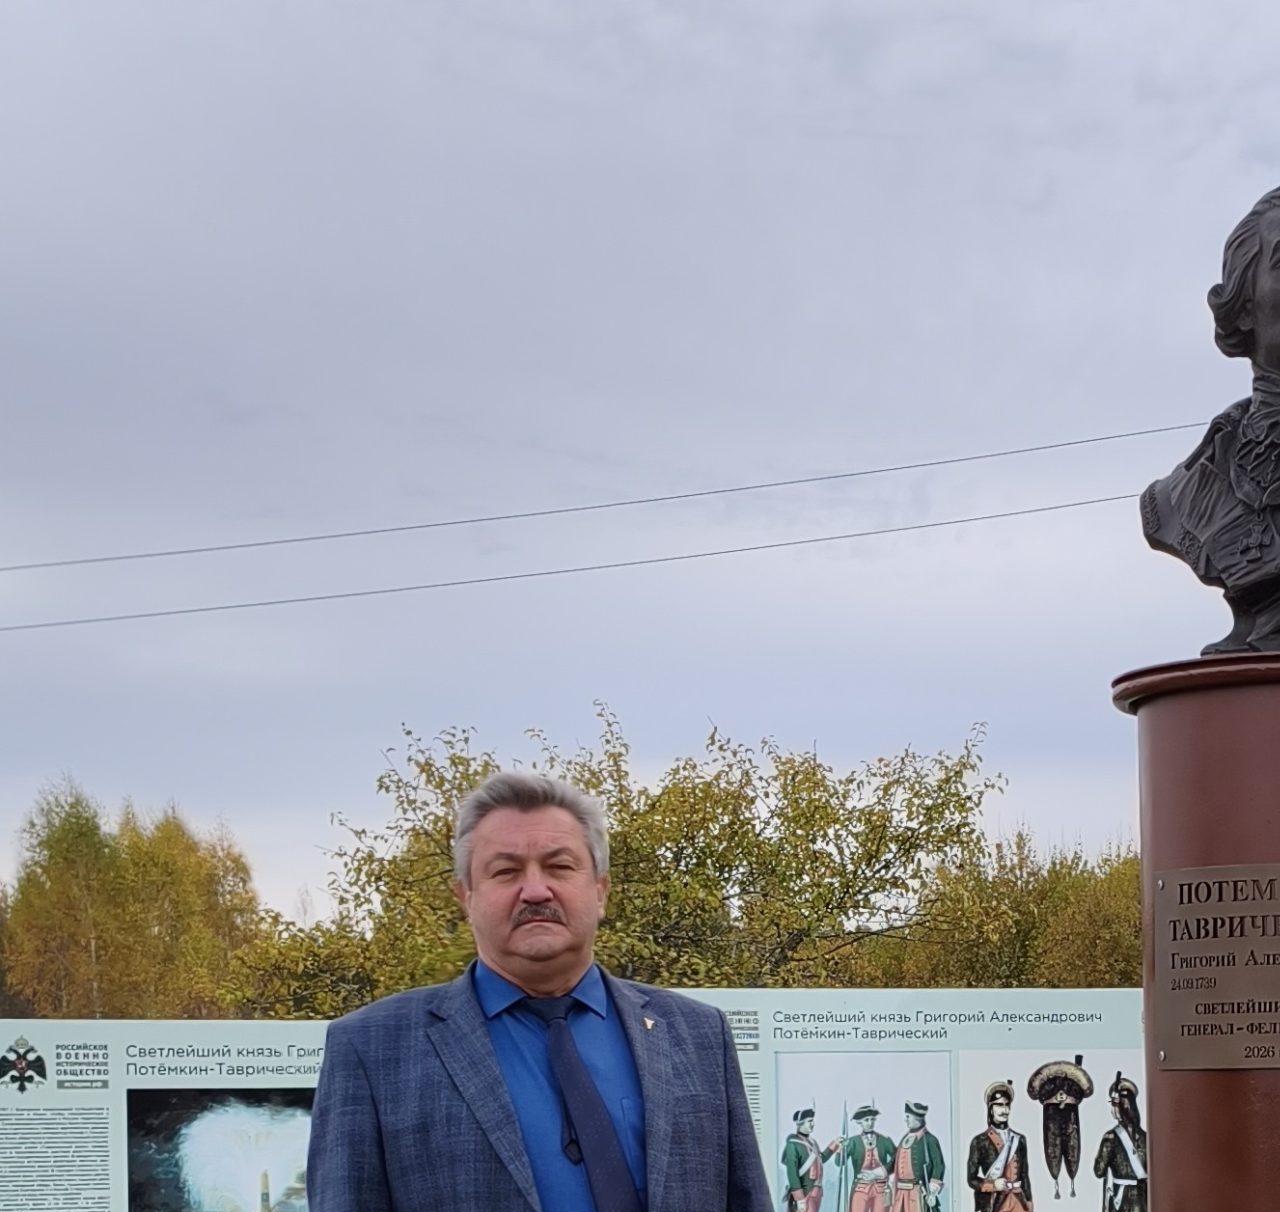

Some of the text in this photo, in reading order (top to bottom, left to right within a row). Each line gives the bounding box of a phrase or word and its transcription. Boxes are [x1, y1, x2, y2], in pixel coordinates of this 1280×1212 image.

[773, 1010, 1103, 1027] Светлейший князь Григорий Александрович
[773, 1026, 948, 1042] Потёмкин-Таврический
[56, 1043, 108, 1051] РОССИЙСКОЕ
[126, 1044, 325, 1060] Светлейший князь Григ
[1245, 1045, 1276, 1058] 2026
[56, 1052, 109, 1060] ВОЕННО
[56, 1069, 109, 1077] ОБЩЕСТВО
